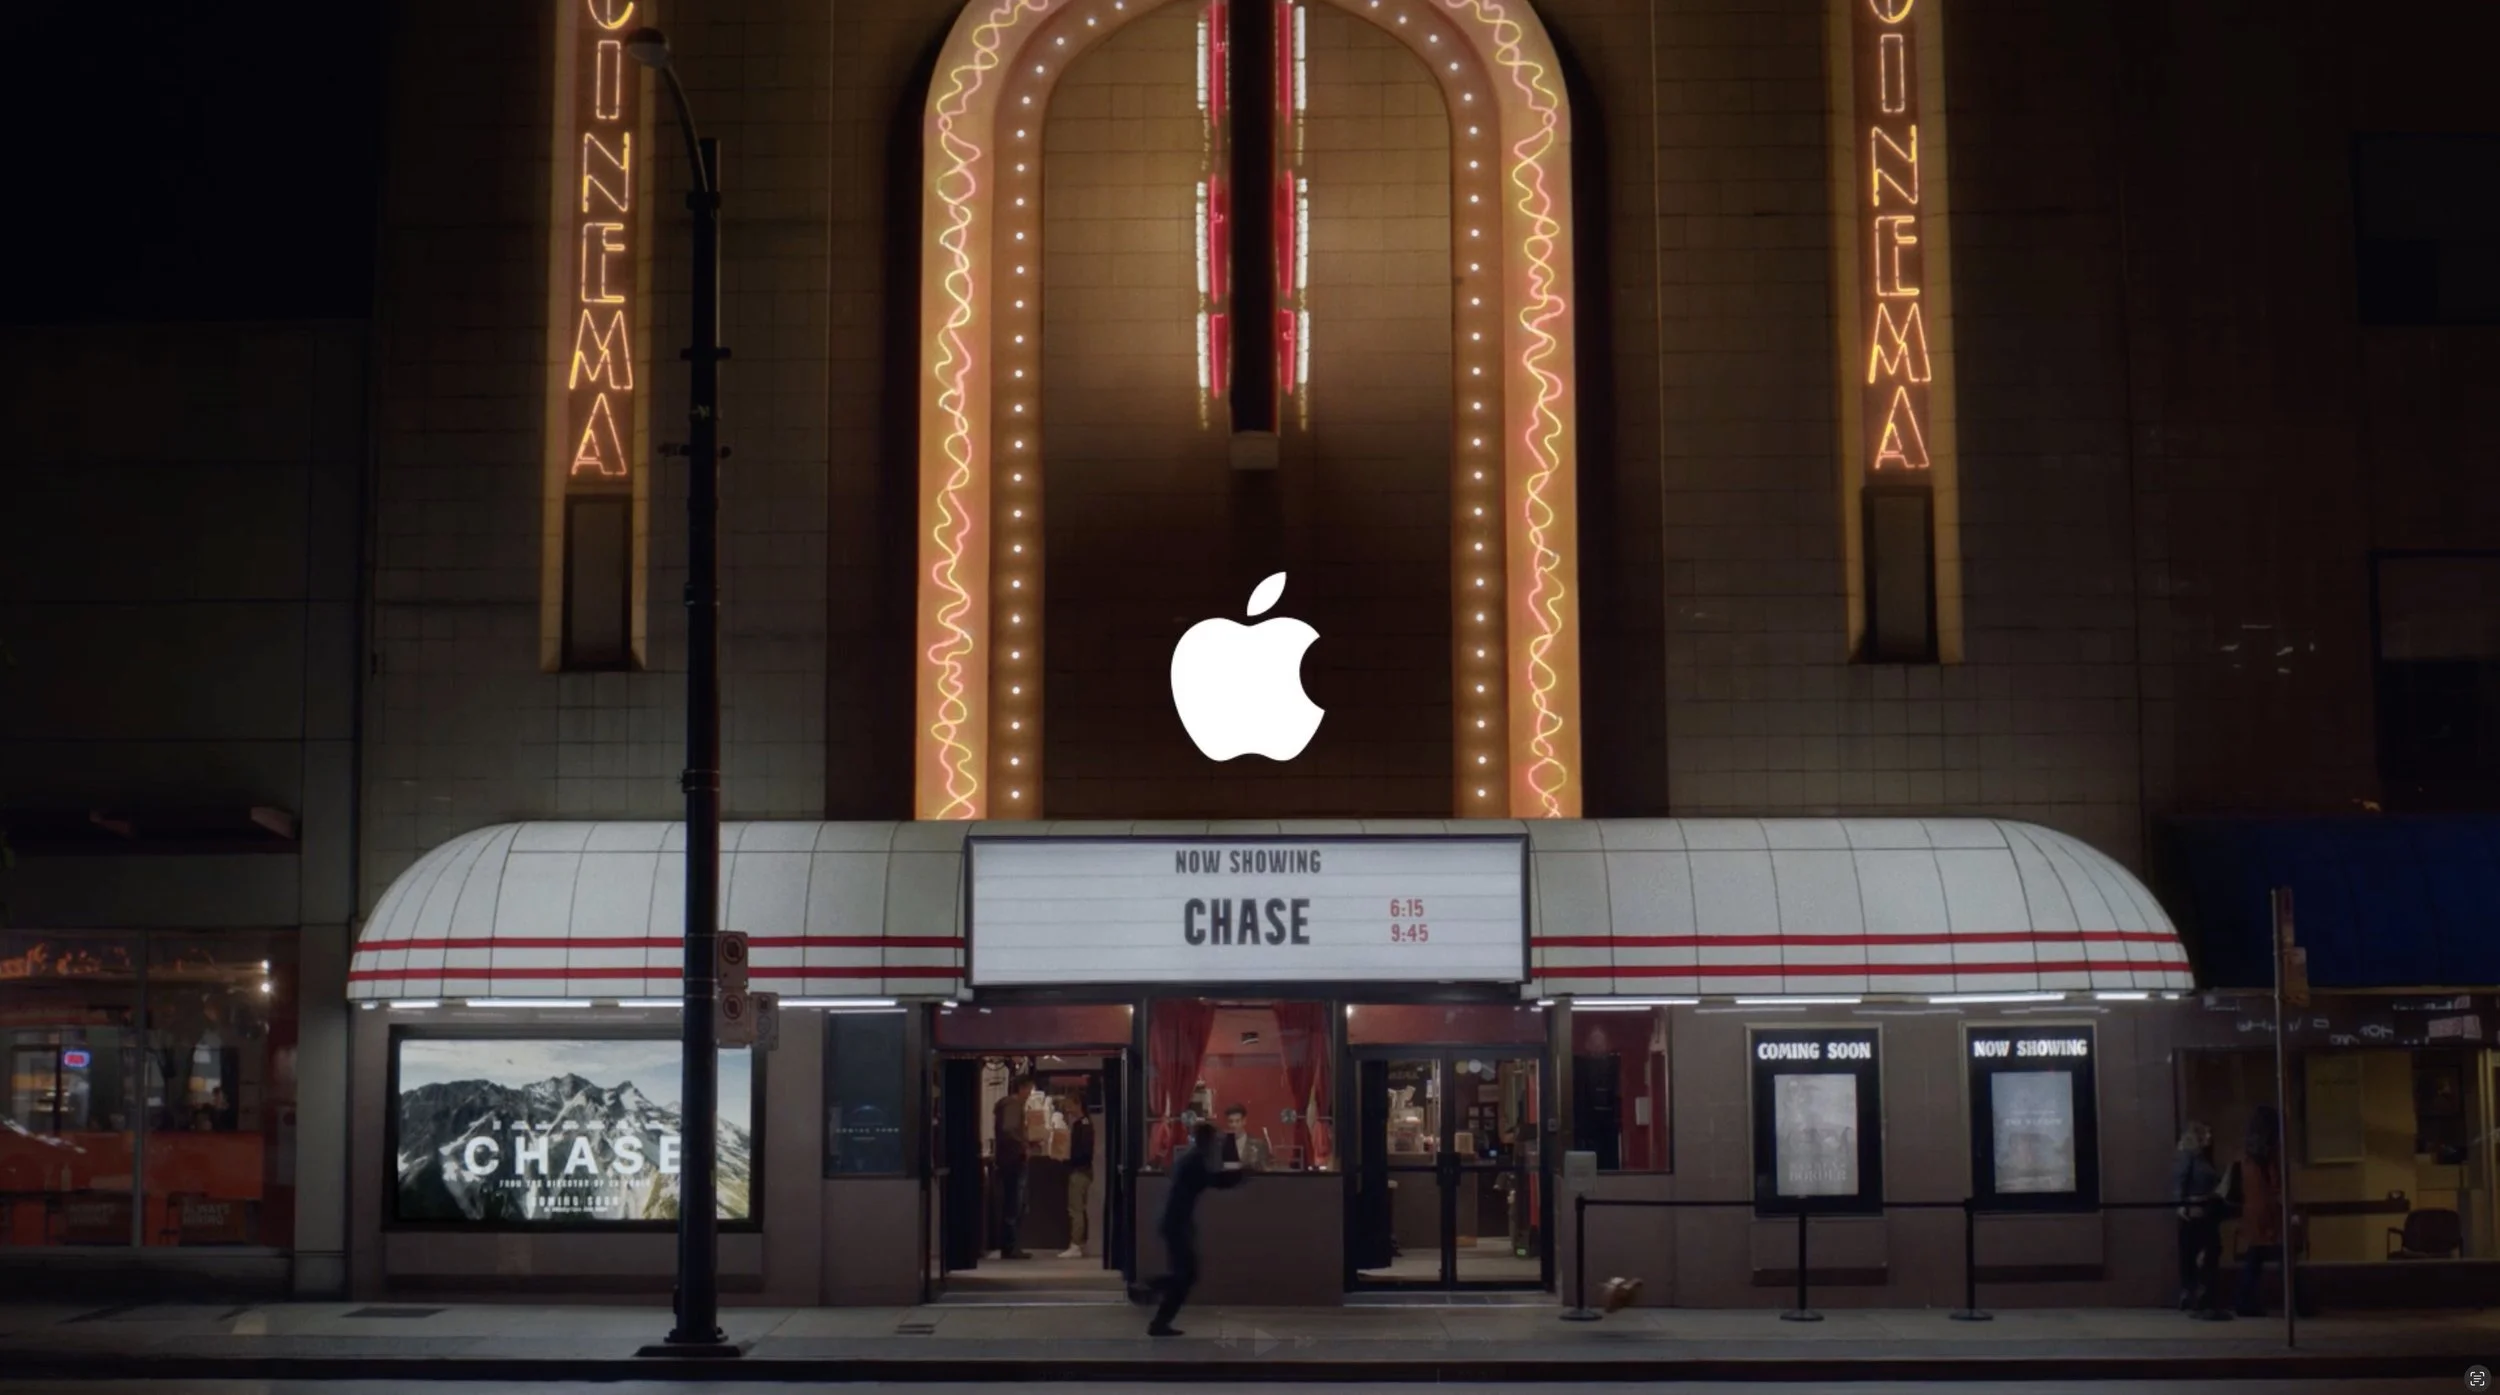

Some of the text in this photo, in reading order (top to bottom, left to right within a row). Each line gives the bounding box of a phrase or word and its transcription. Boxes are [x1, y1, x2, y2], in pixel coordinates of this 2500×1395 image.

[1867, 0, 1932, 469] INEMA
[1175, 849, 1322, 874] NOW SHOWING
[1389, 898, 1425, 918] 6:15
[1183, 898, 1310, 946] CHASE
[1391, 923, 1429, 943] 9:45
[1757, 1041, 1872, 1060] COMING SOON
[1973, 1038, 2088, 1058] NOW SHOWING
[464, 1135, 681, 1175] CHASE
